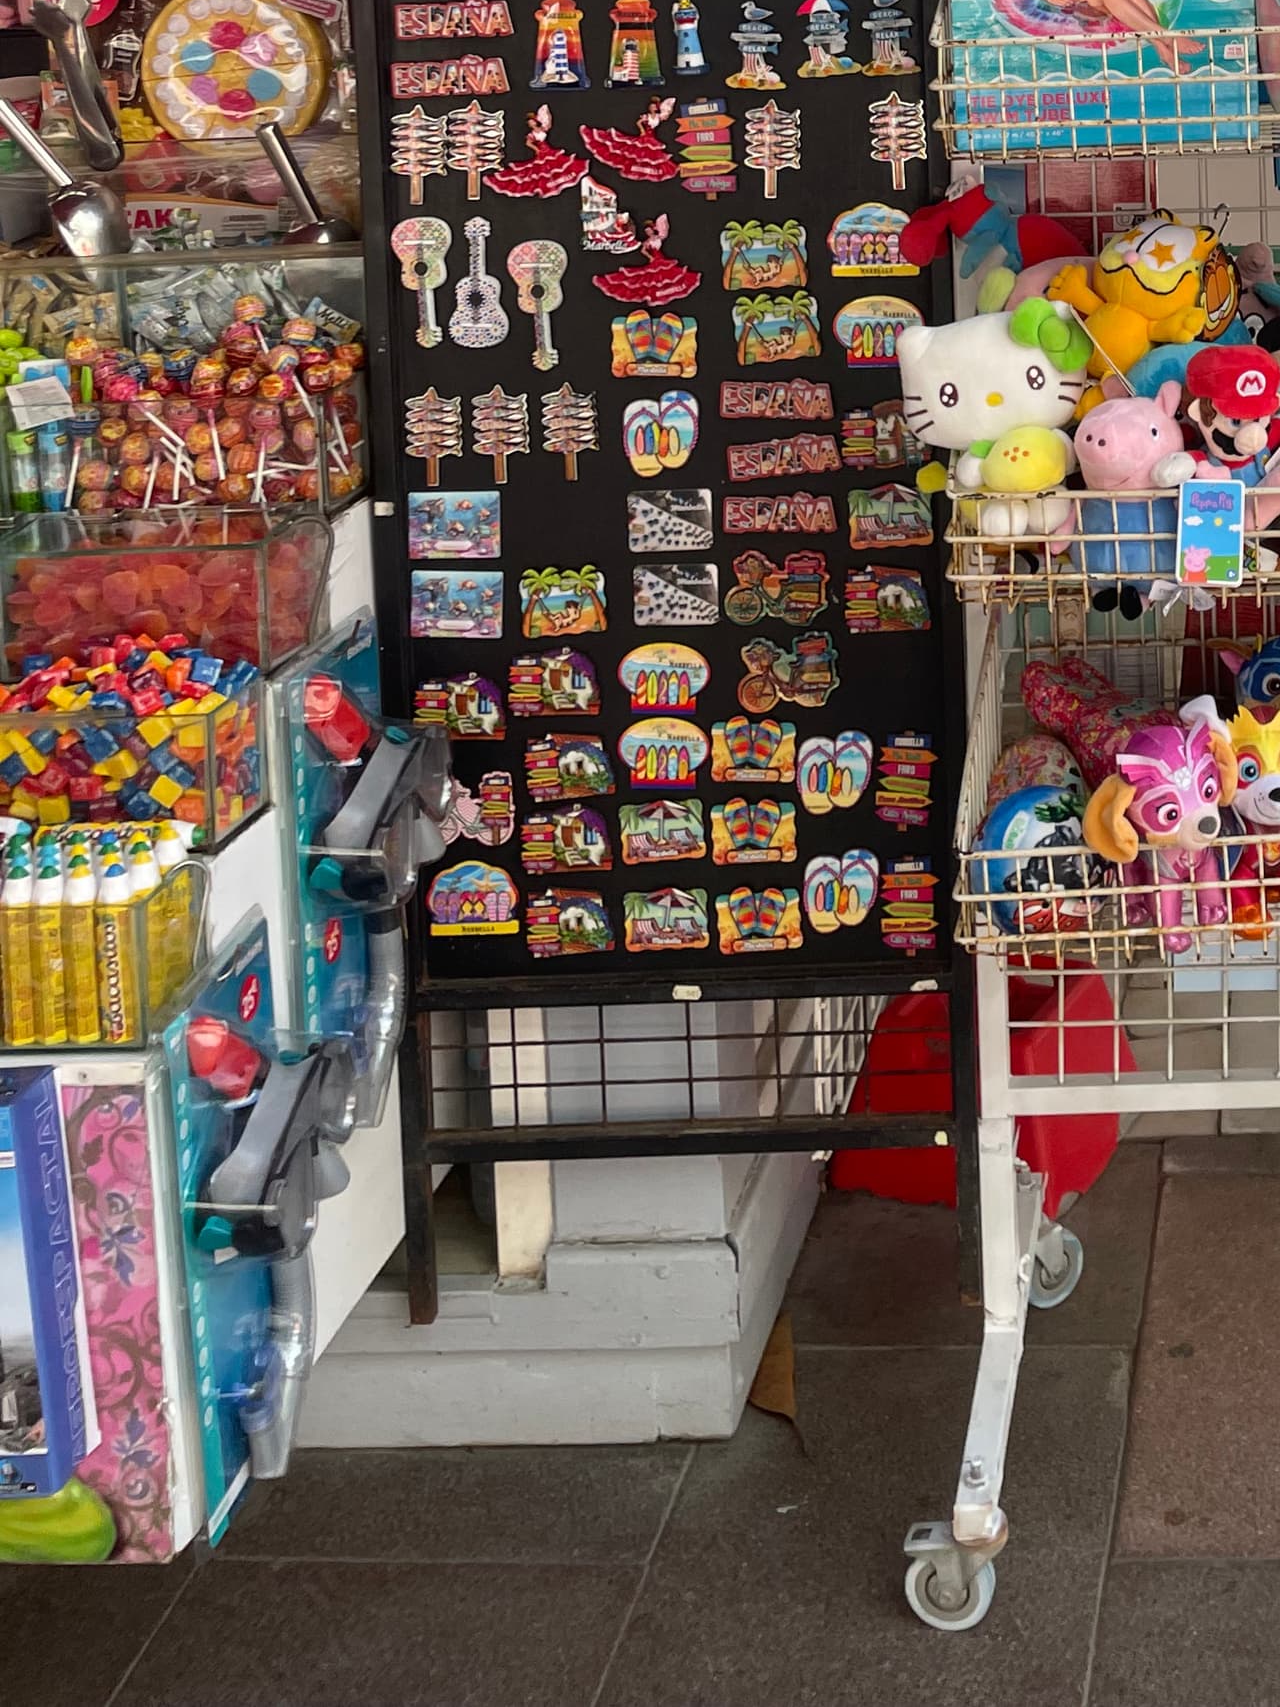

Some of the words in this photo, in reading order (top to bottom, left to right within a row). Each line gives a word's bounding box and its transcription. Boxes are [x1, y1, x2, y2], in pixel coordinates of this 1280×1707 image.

[393, 56, 509, 96] ESPAÑA
[724, 379, 833, 420] ESPAÑA
[1240, 374, 1264, 393] M
[729, 434, 841, 480] ESPAÑA
[727, 492, 836, 533] ESPAÑA
